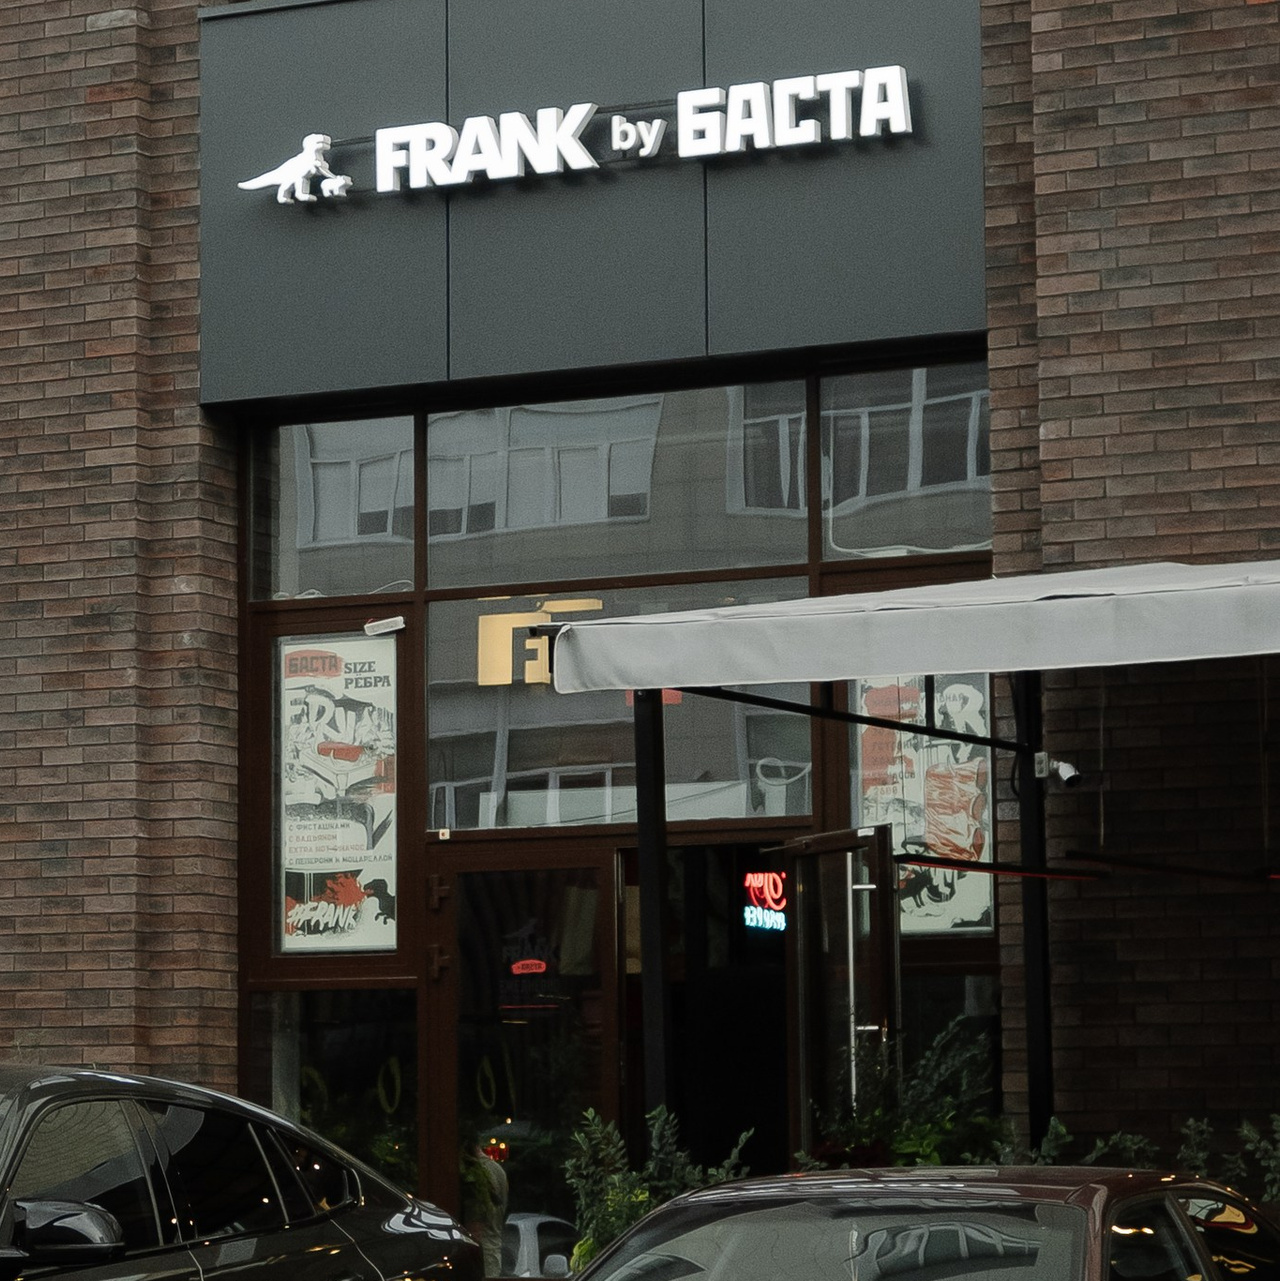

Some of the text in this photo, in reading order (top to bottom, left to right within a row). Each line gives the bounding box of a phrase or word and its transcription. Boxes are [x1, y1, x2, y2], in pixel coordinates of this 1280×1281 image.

[375, 64, 913, 193] FRANK by БАСТА
[288, 654, 338, 674] БАСТА
[344, 661, 376, 674] SIZE
[344, 673, 392, 690] РЁБРА
[286, 900, 359, 931] #FRANK
